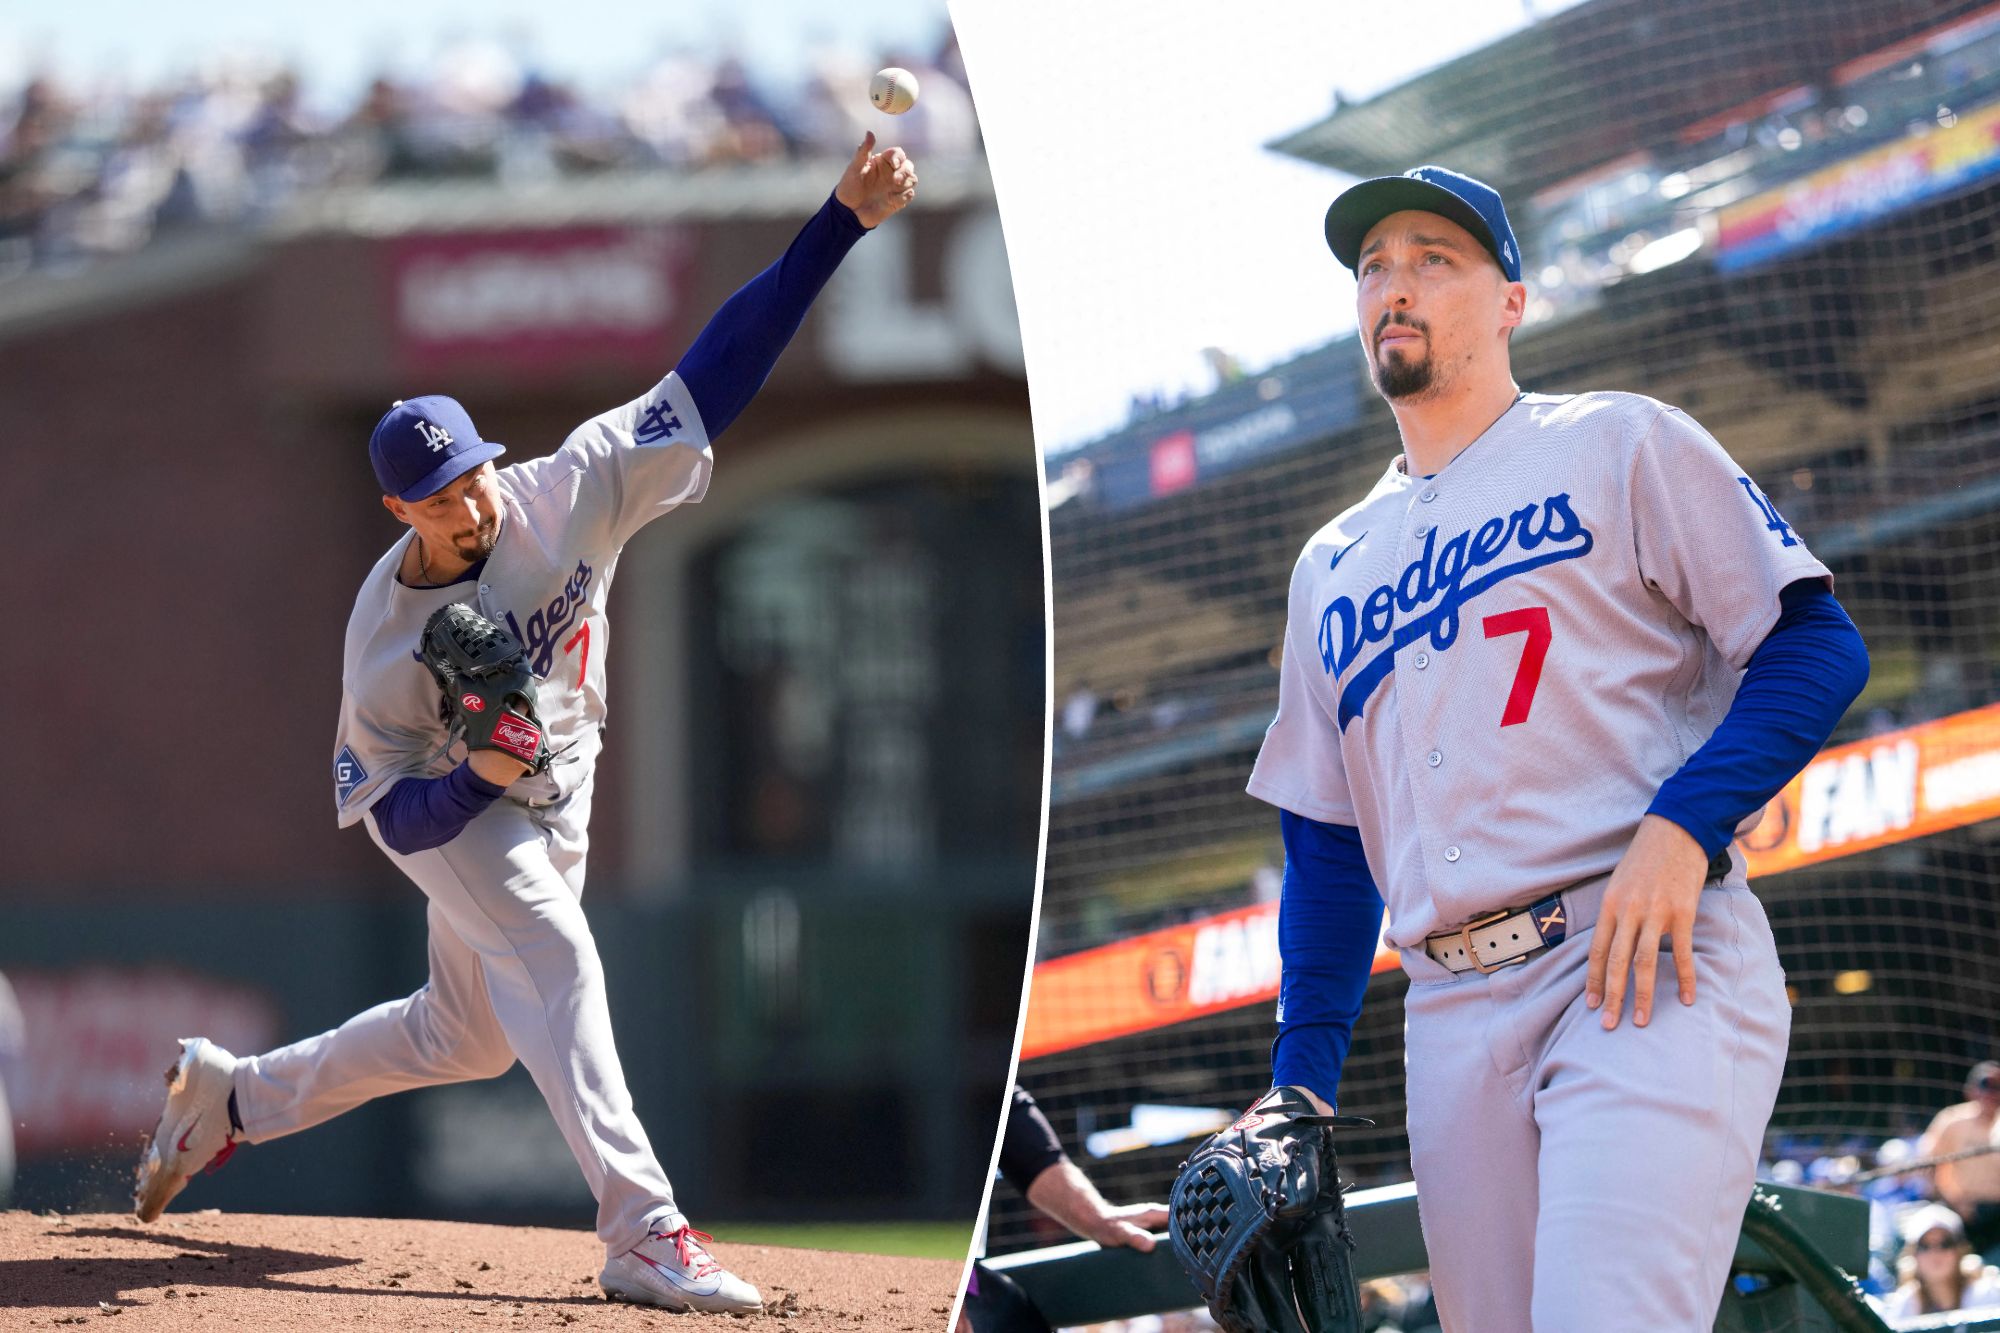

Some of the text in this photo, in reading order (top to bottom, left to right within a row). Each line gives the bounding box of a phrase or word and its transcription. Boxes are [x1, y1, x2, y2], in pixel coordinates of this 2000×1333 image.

[414, 421, 453, 452] LA
[1318, 493, 1592, 682] Dodgers
[563, 619, 590, 692] 7
[1483, 606, 1552, 727] 7
[463, 695, 481, 711] R
[499, 725, 535, 746] Rawlings
[338, 763, 352, 781] G
